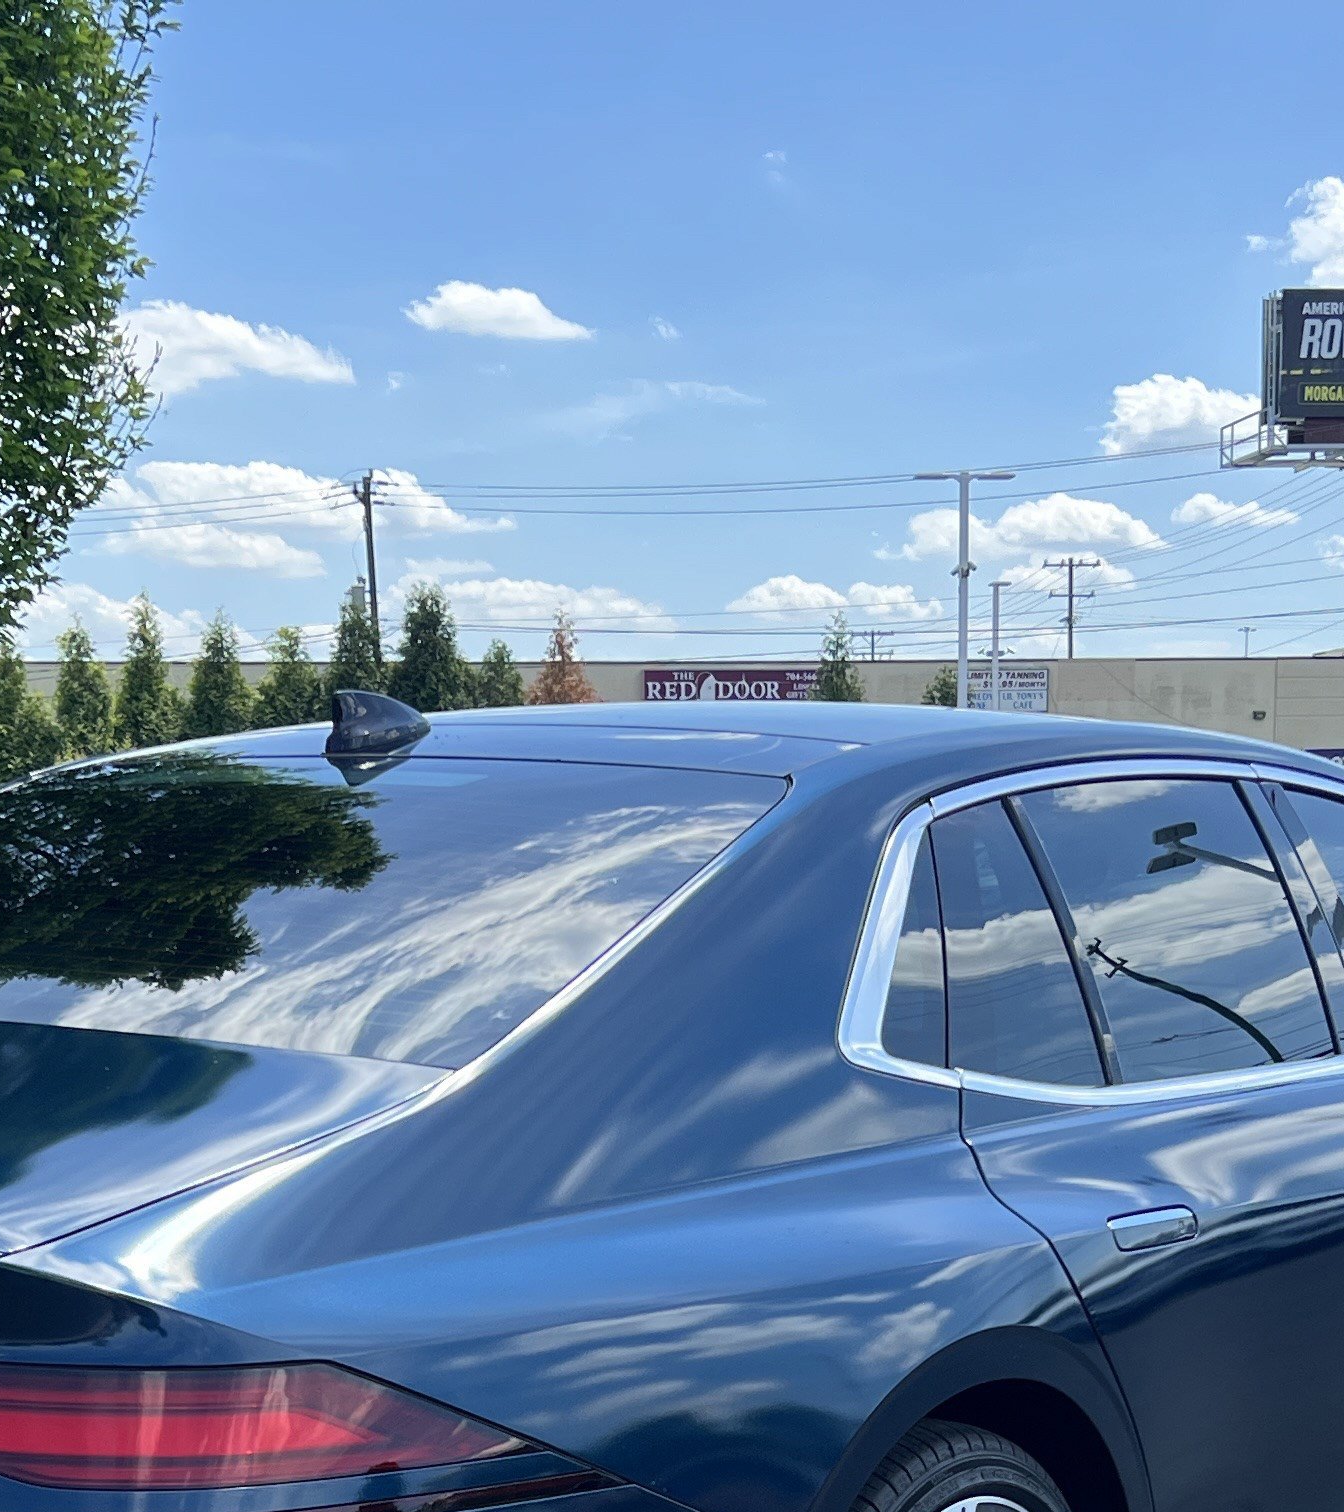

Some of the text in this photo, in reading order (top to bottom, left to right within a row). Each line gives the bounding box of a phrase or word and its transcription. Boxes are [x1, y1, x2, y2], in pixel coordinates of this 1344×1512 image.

[672, 671, 695, 681] THE
[1005, 671, 1045, 680] TANNING
[646, 681, 697, 700] RED
[718, 680, 781, 700] DOOR
